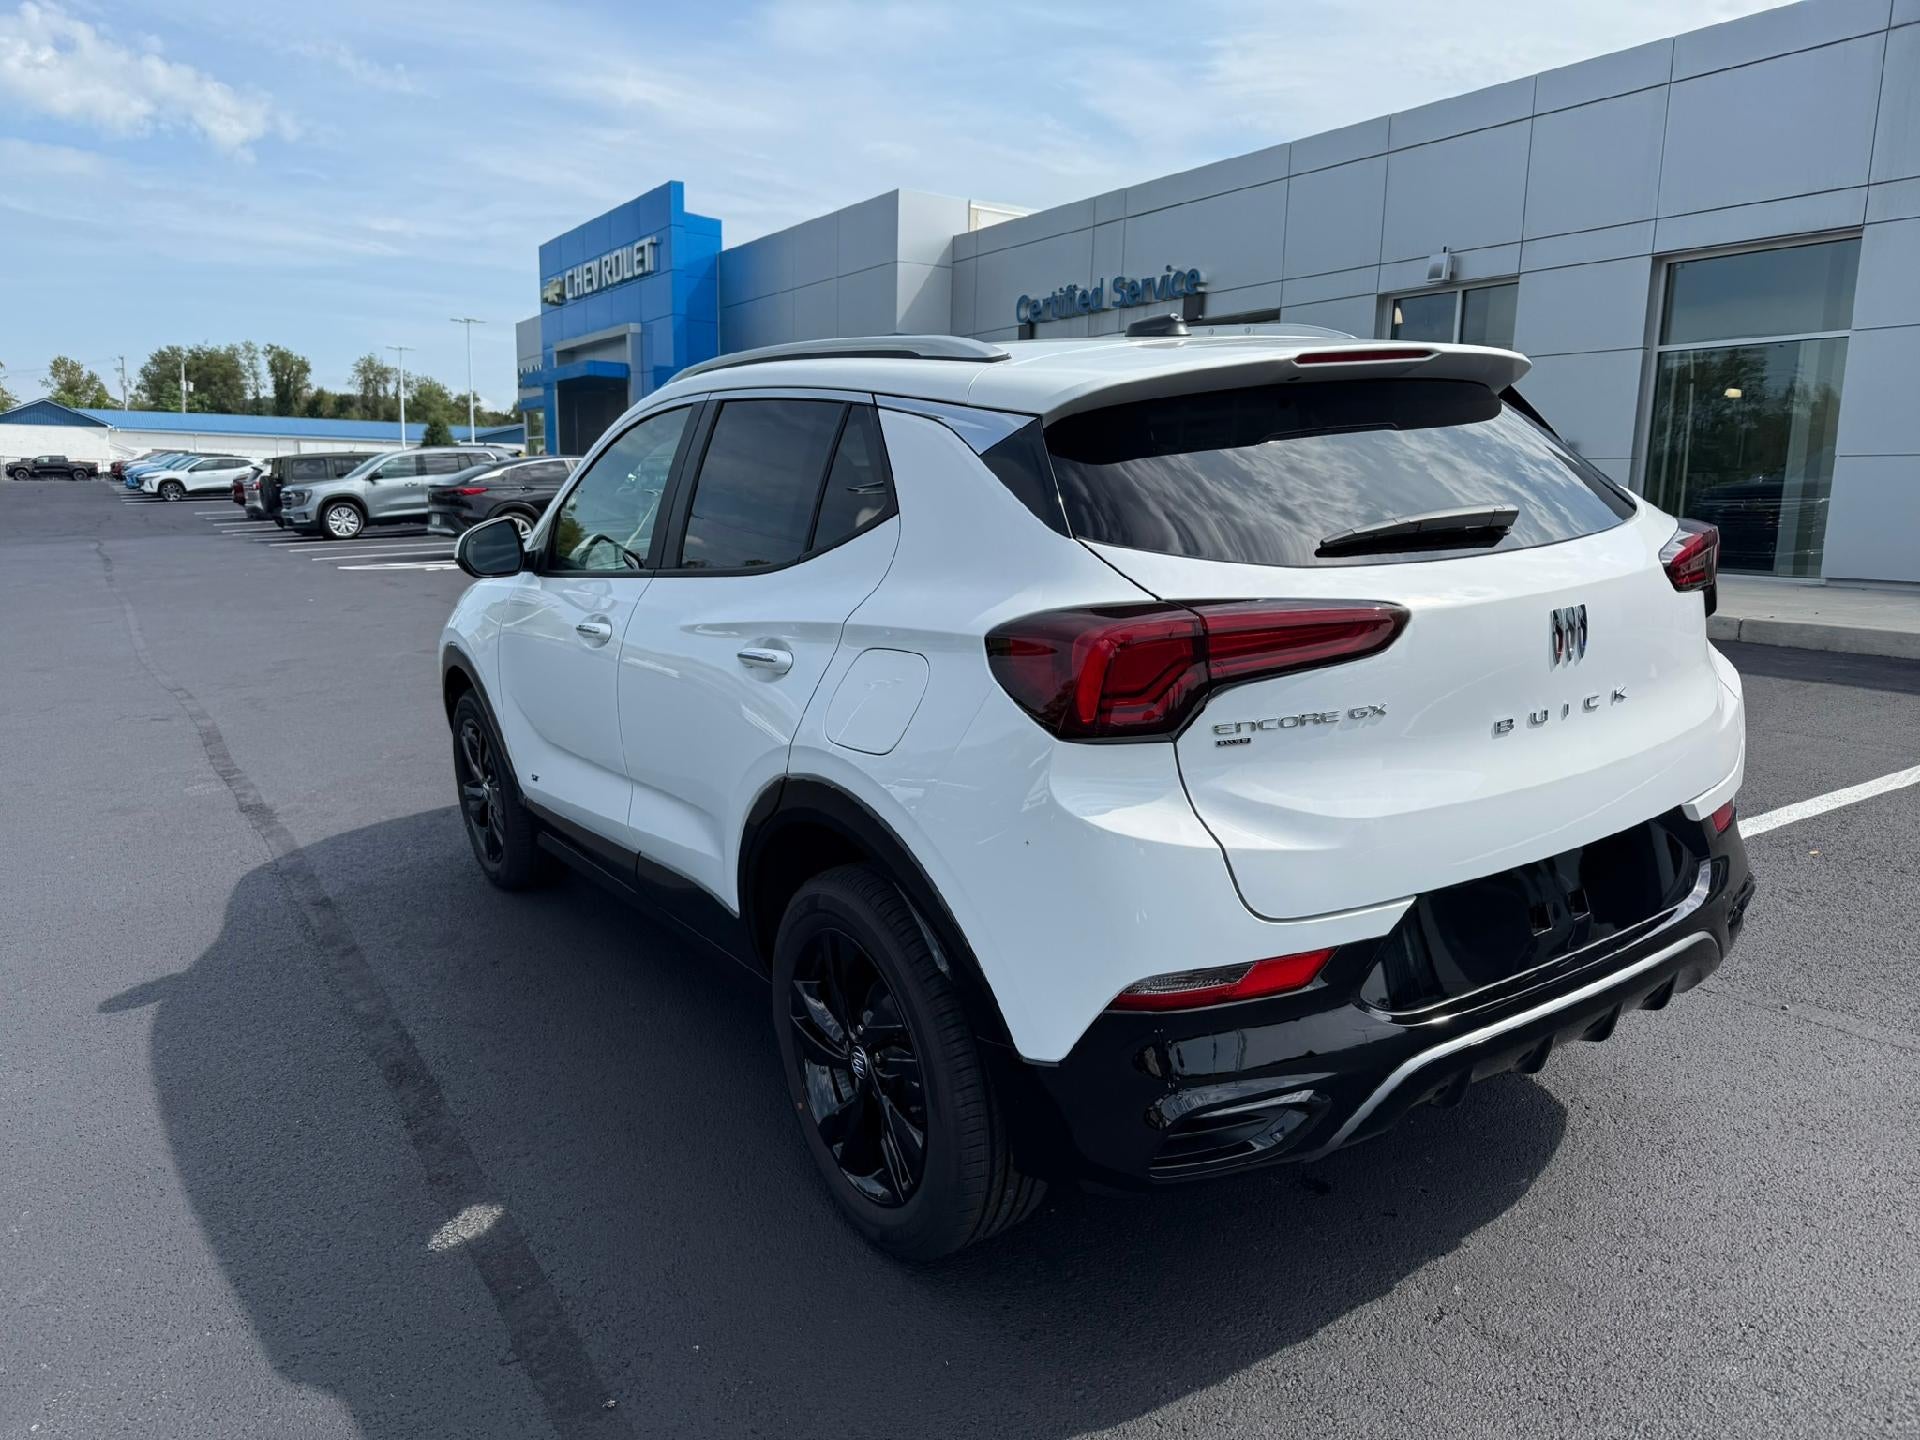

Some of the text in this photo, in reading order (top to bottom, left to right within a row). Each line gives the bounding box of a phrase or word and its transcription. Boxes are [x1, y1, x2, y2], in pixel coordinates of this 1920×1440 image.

[564, 236, 660, 299] CHEVROLET
[1016, 265, 1207, 323] Certified Service
[1213, 702, 1387, 735] ENCORE GX
[1492, 685, 1628, 736] BUICK
